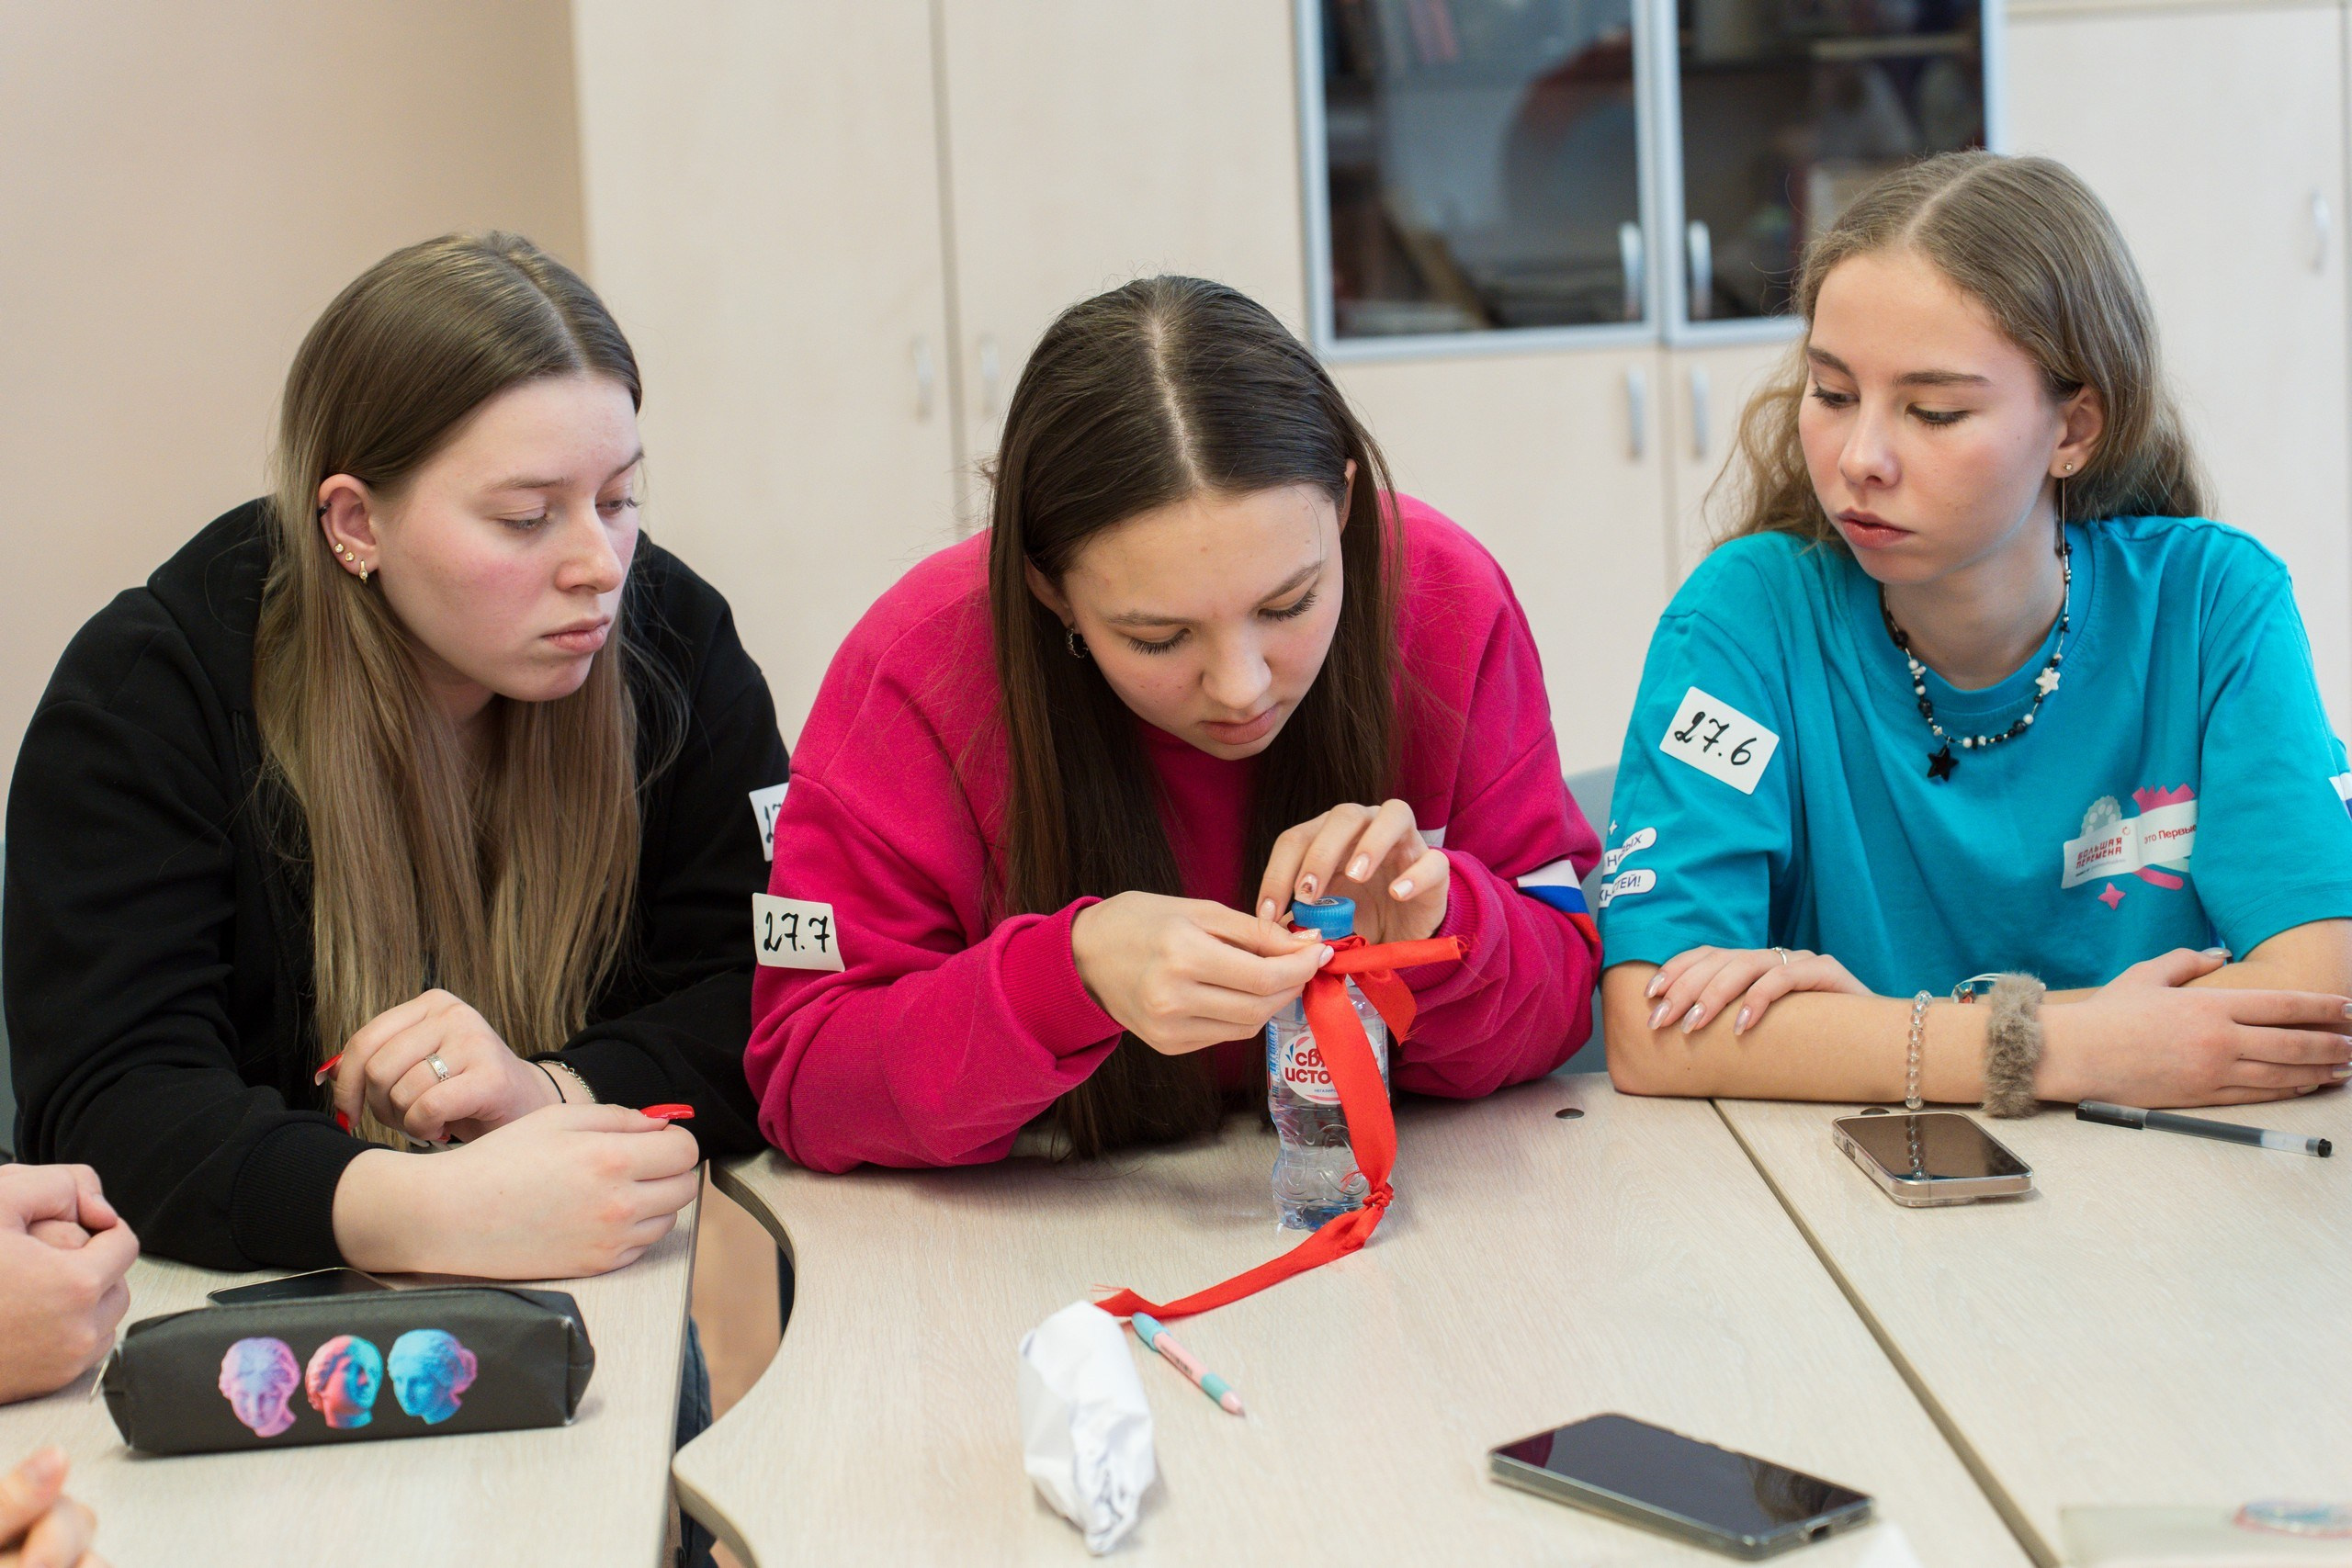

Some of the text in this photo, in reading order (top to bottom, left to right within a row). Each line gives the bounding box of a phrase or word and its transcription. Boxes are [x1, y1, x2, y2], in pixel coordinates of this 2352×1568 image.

[1674, 711, 1758, 766] 27.6
[2076, 846, 2122, 869] ПЕРЕМЕНА
[2077, 837, 2122, 861] БОЛЬШАЯ
[763, 911, 831, 953] 27.7
[1284, 1067, 1331, 1084] ИСТО
